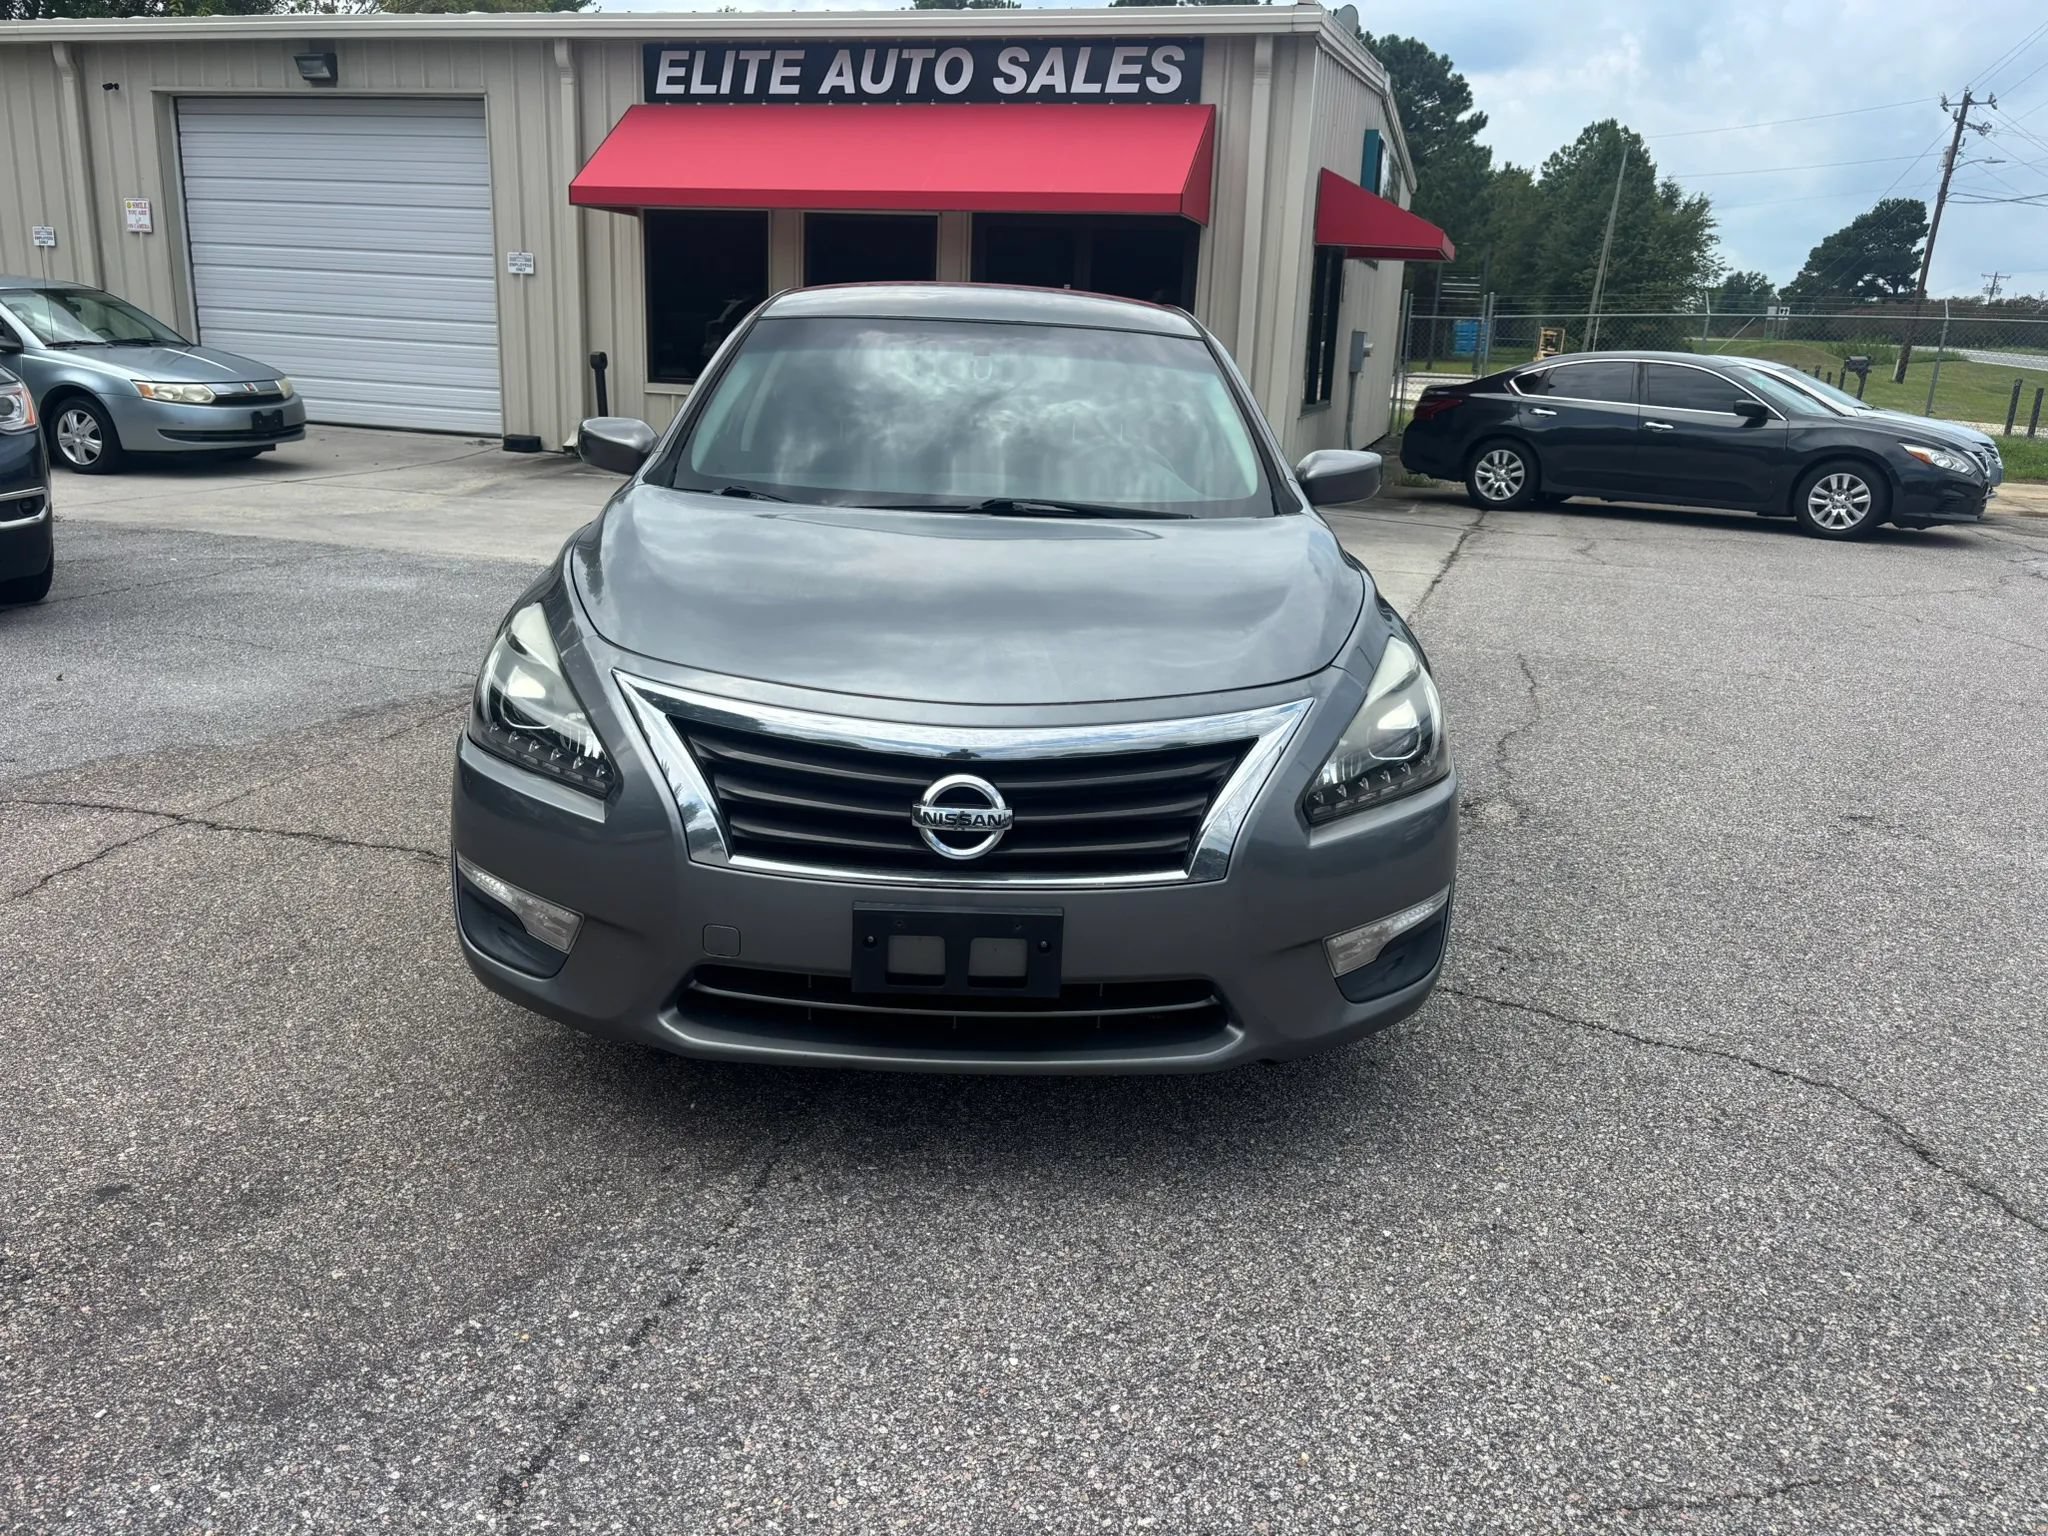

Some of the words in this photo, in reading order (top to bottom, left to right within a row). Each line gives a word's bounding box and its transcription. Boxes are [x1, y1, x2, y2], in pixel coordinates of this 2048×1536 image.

[655, 49, 805, 95] ELITE
[817, 47, 974, 95] AUTO
[992, 45, 1186, 95] SALES
[921, 811, 1002, 827] NISSAN
